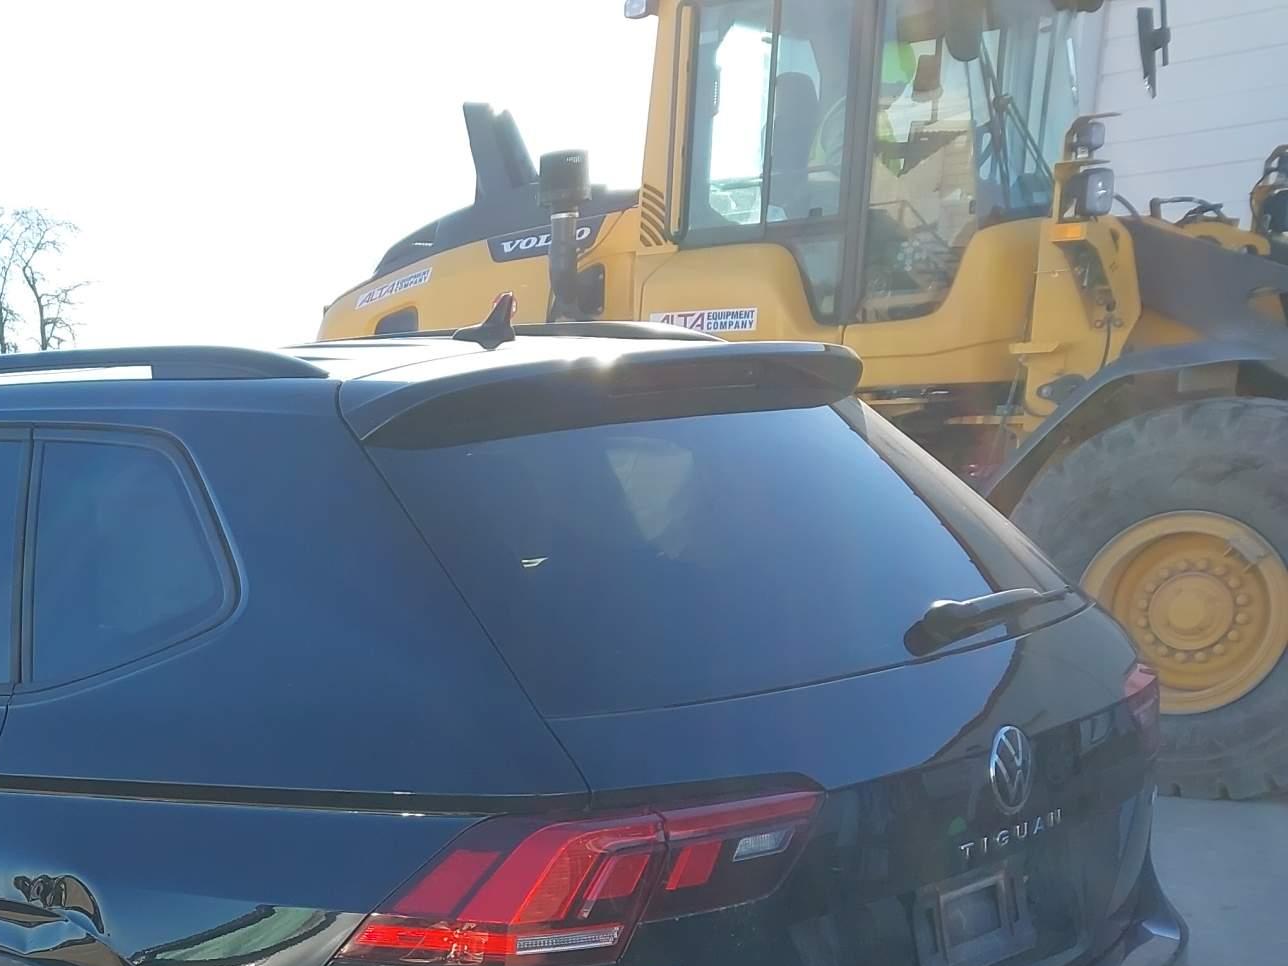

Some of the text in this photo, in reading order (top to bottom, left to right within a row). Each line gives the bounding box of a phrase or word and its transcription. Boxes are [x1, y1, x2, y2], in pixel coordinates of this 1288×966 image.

[501, 227, 591, 253] VOLO
[706, 310, 755, 321] EQUIPMENT
[706, 319, 754, 331] COMPANY
[959, 808, 1063, 858] TIGUAN
